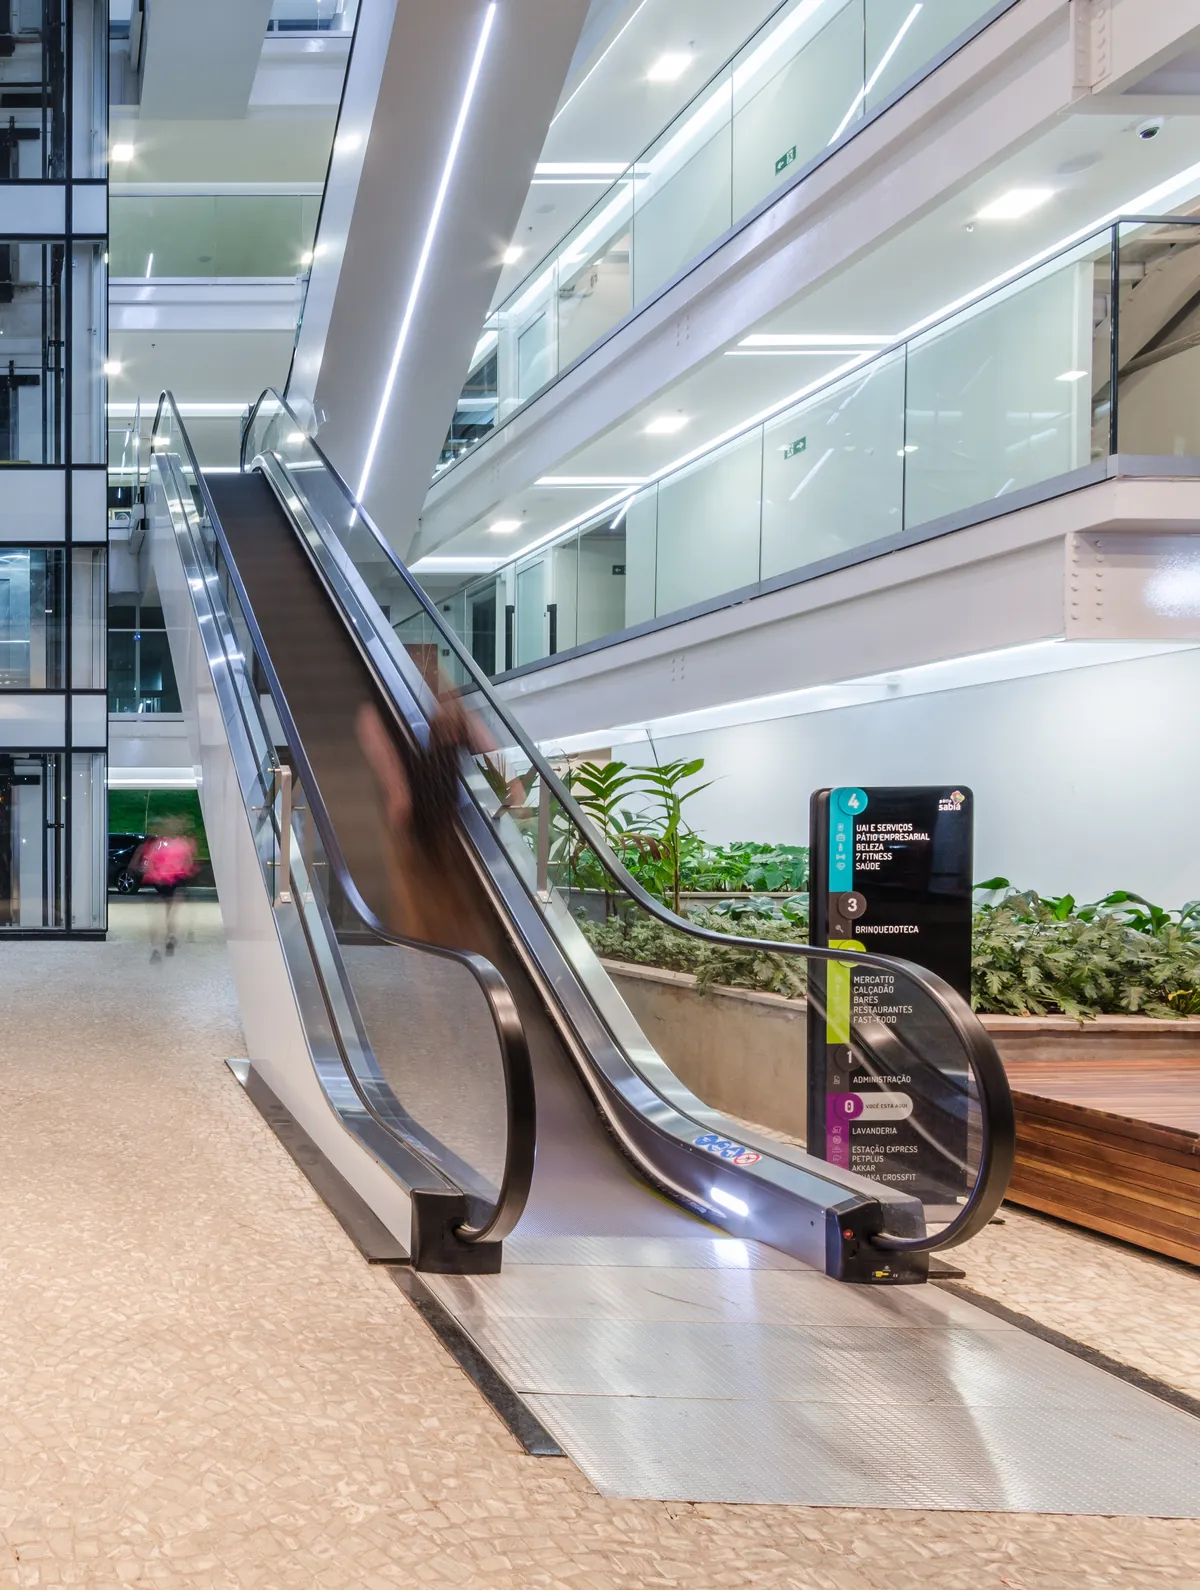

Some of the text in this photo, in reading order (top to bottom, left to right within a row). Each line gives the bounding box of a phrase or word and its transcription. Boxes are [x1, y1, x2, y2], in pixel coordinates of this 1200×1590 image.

[848, 793, 859, 809] 4
[938, 802, 961, 810] sabiá
[877, 824, 913, 832] SERVIÇOS
[856, 833, 878, 841] PÁTIO
[856, 861, 880, 870] SAÚDE
[848, 898, 857, 912] 3
[855, 925, 919, 934] BRINQUEDOTECA
[854, 984, 894, 995] CALÇADÃO
[854, 1005, 913, 1014] RESTAURANTES
[854, 1016, 897, 1024] FAST-FOOD
[847, 1050, 852, 1064] 1
[853, 1074, 911, 1084] ADMINISTRAÇÃO
[845, 1100, 854, 1113] 0
[852, 1144, 884, 1154] ESTAÇÃO
